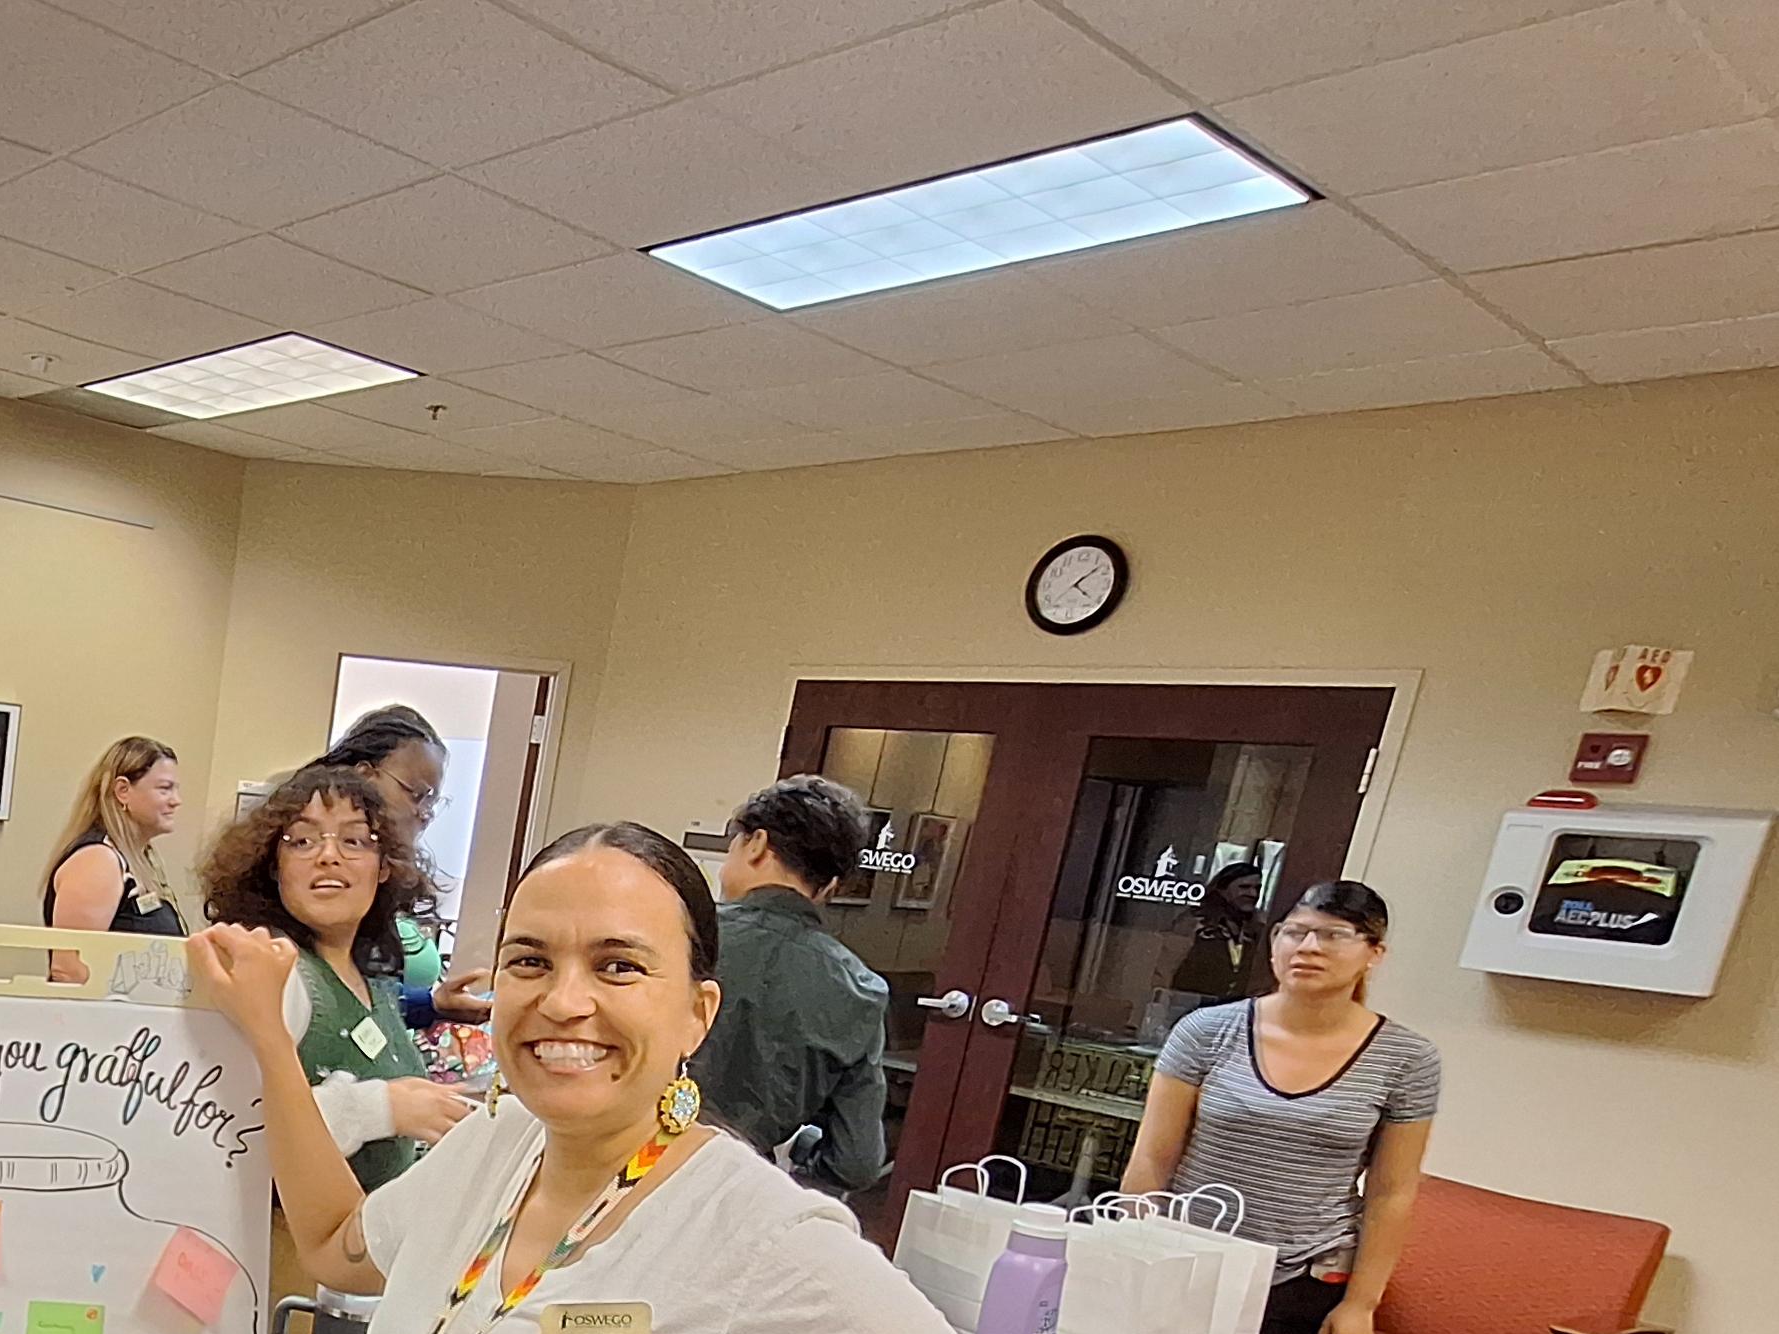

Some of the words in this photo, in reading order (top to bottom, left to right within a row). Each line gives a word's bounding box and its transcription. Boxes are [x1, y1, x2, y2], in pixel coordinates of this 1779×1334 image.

[1638, 648, 1671, 663] AED
[1118, 876, 1206, 901] OSWEGO
[573, 1313, 632, 1326] OSWEGO
